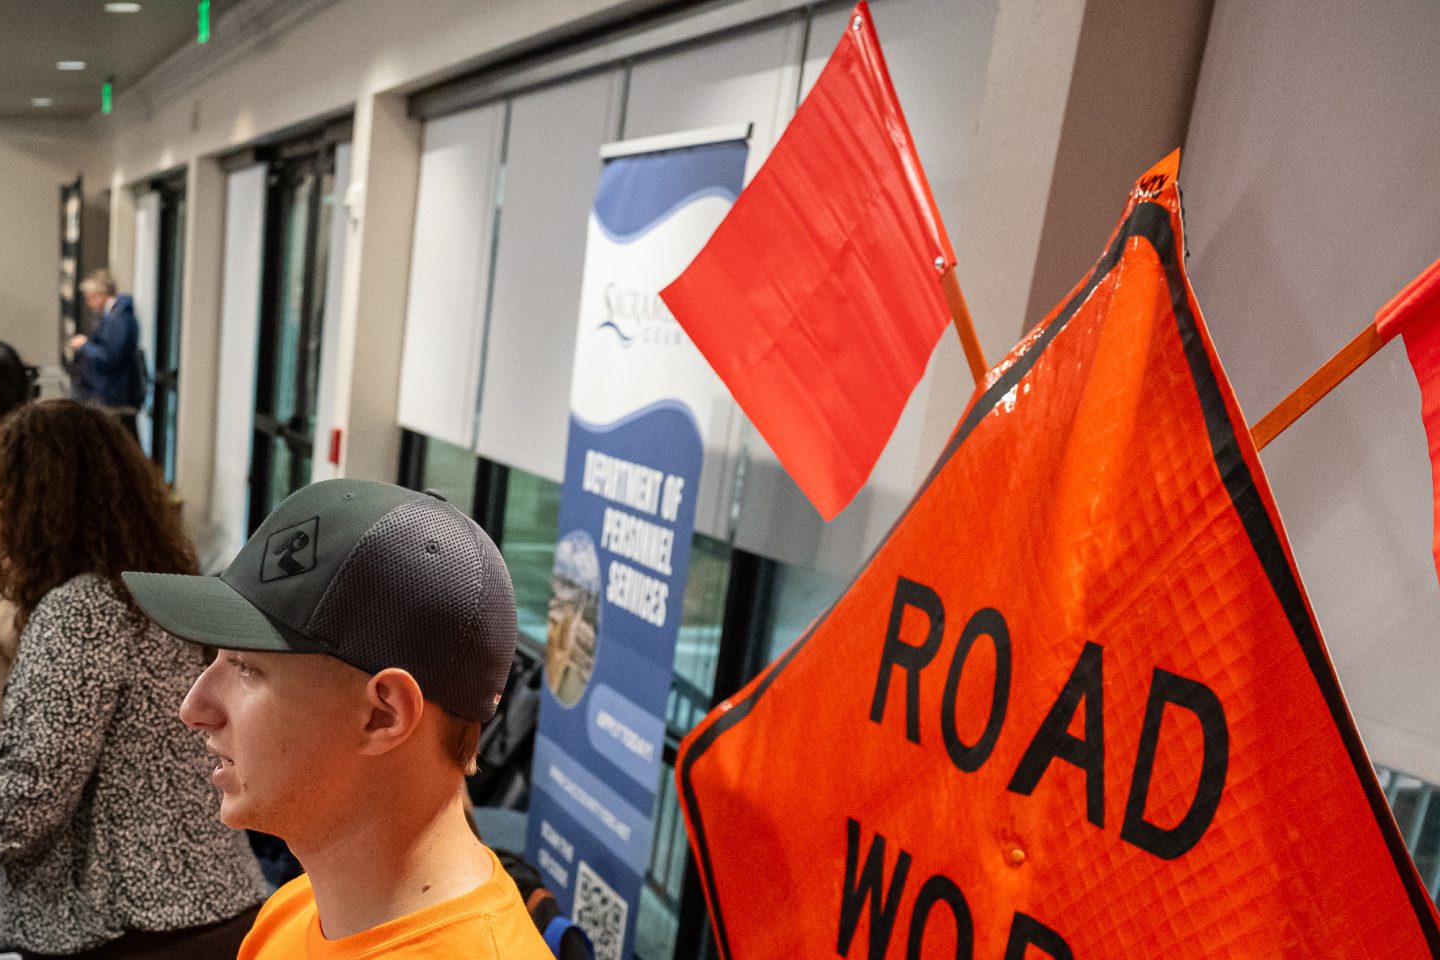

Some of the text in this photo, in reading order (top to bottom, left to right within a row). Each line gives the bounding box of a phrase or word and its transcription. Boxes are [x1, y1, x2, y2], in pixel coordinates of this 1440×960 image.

[600, 507, 674, 577] PERSONNEL
[606, 560, 670, 628] SERVICES
[869, 576, 1229, 860] ROAD
